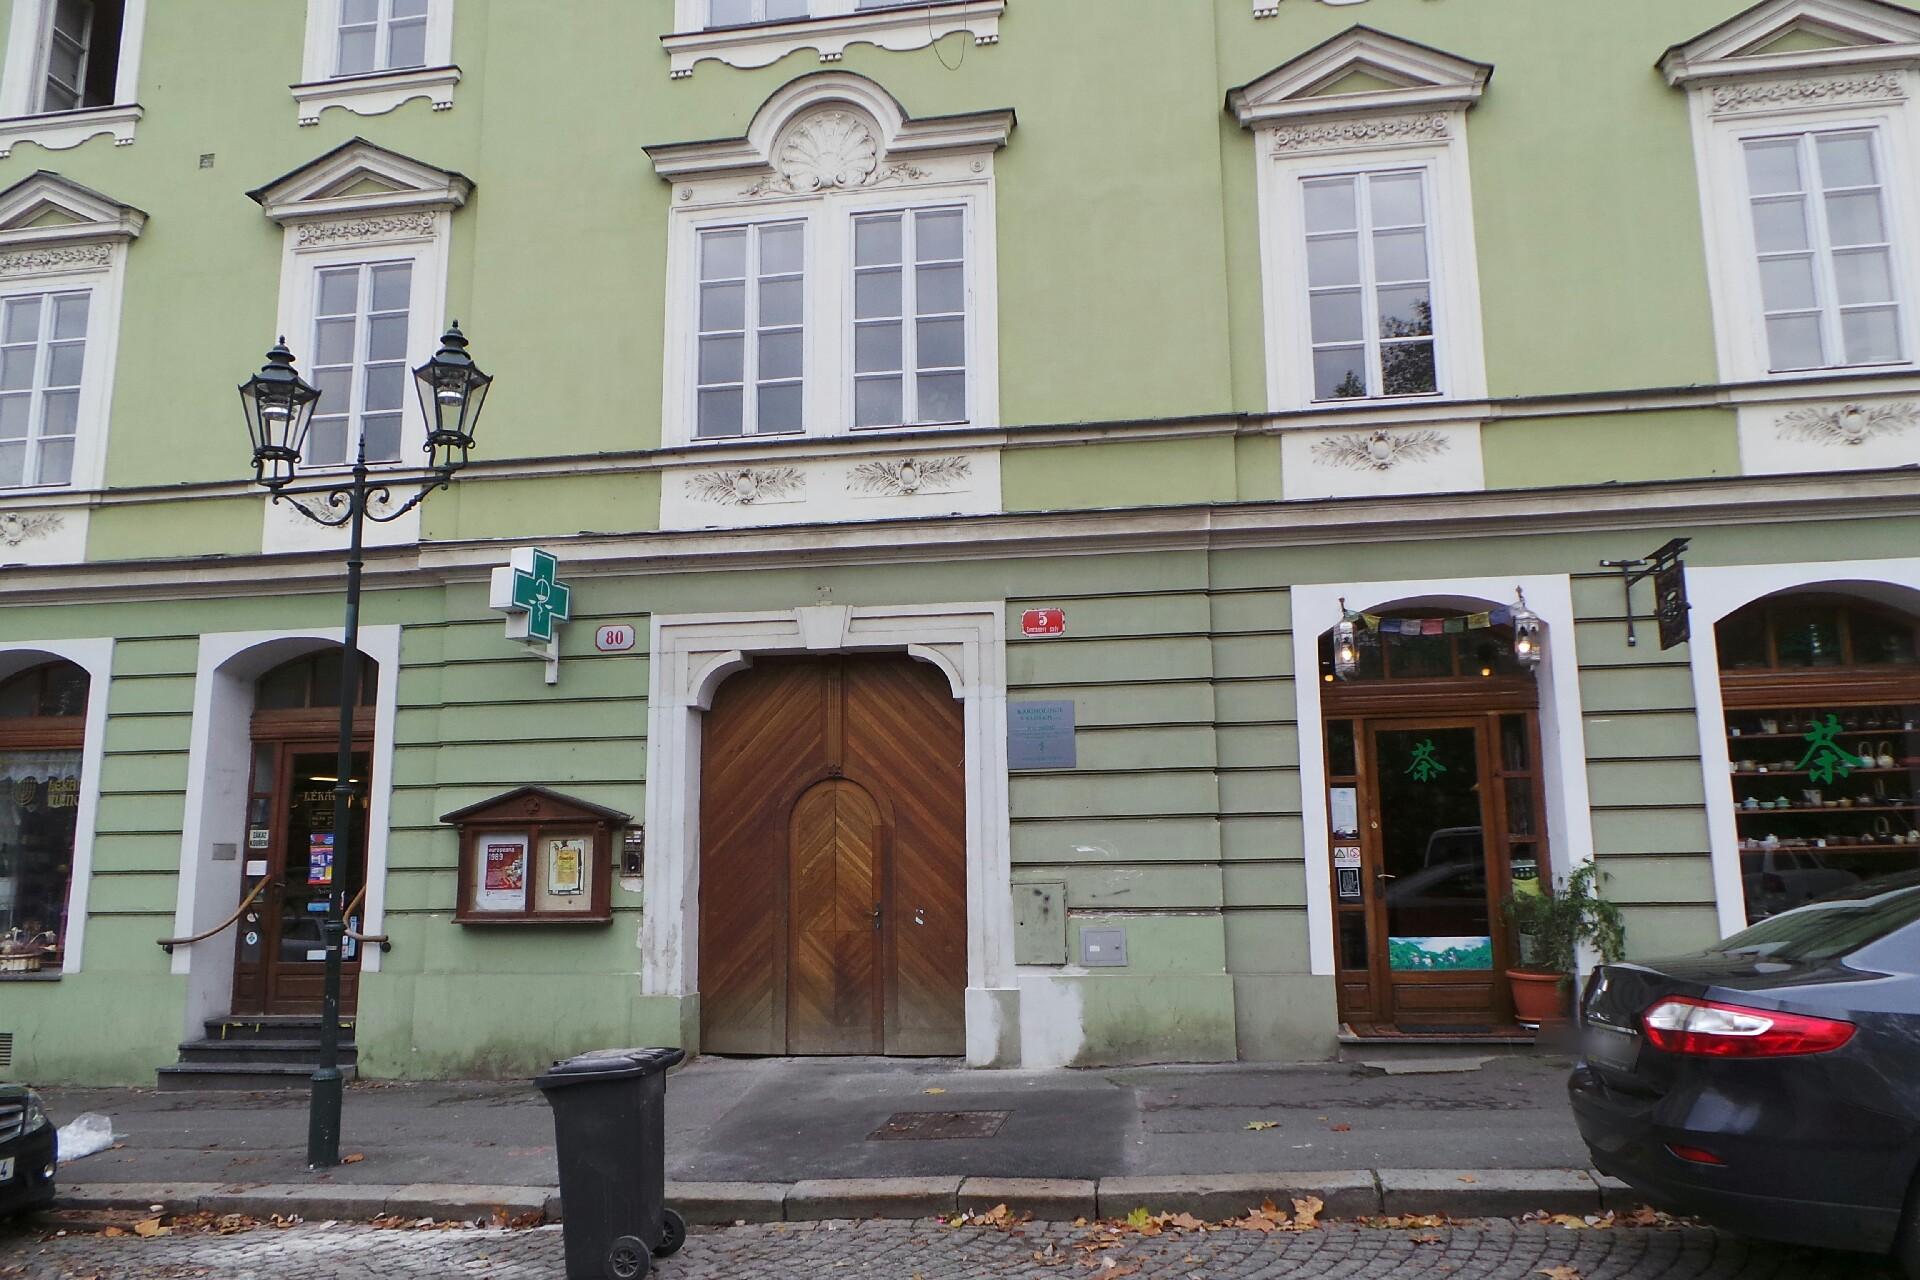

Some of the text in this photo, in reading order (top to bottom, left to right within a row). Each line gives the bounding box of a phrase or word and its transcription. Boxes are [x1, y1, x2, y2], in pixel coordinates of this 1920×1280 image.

[1038, 611, 1048, 626] 5
[606, 630, 624, 645] 80
[1403, 738, 1447, 783] 茶
[1791, 713, 1864, 785] 茶
